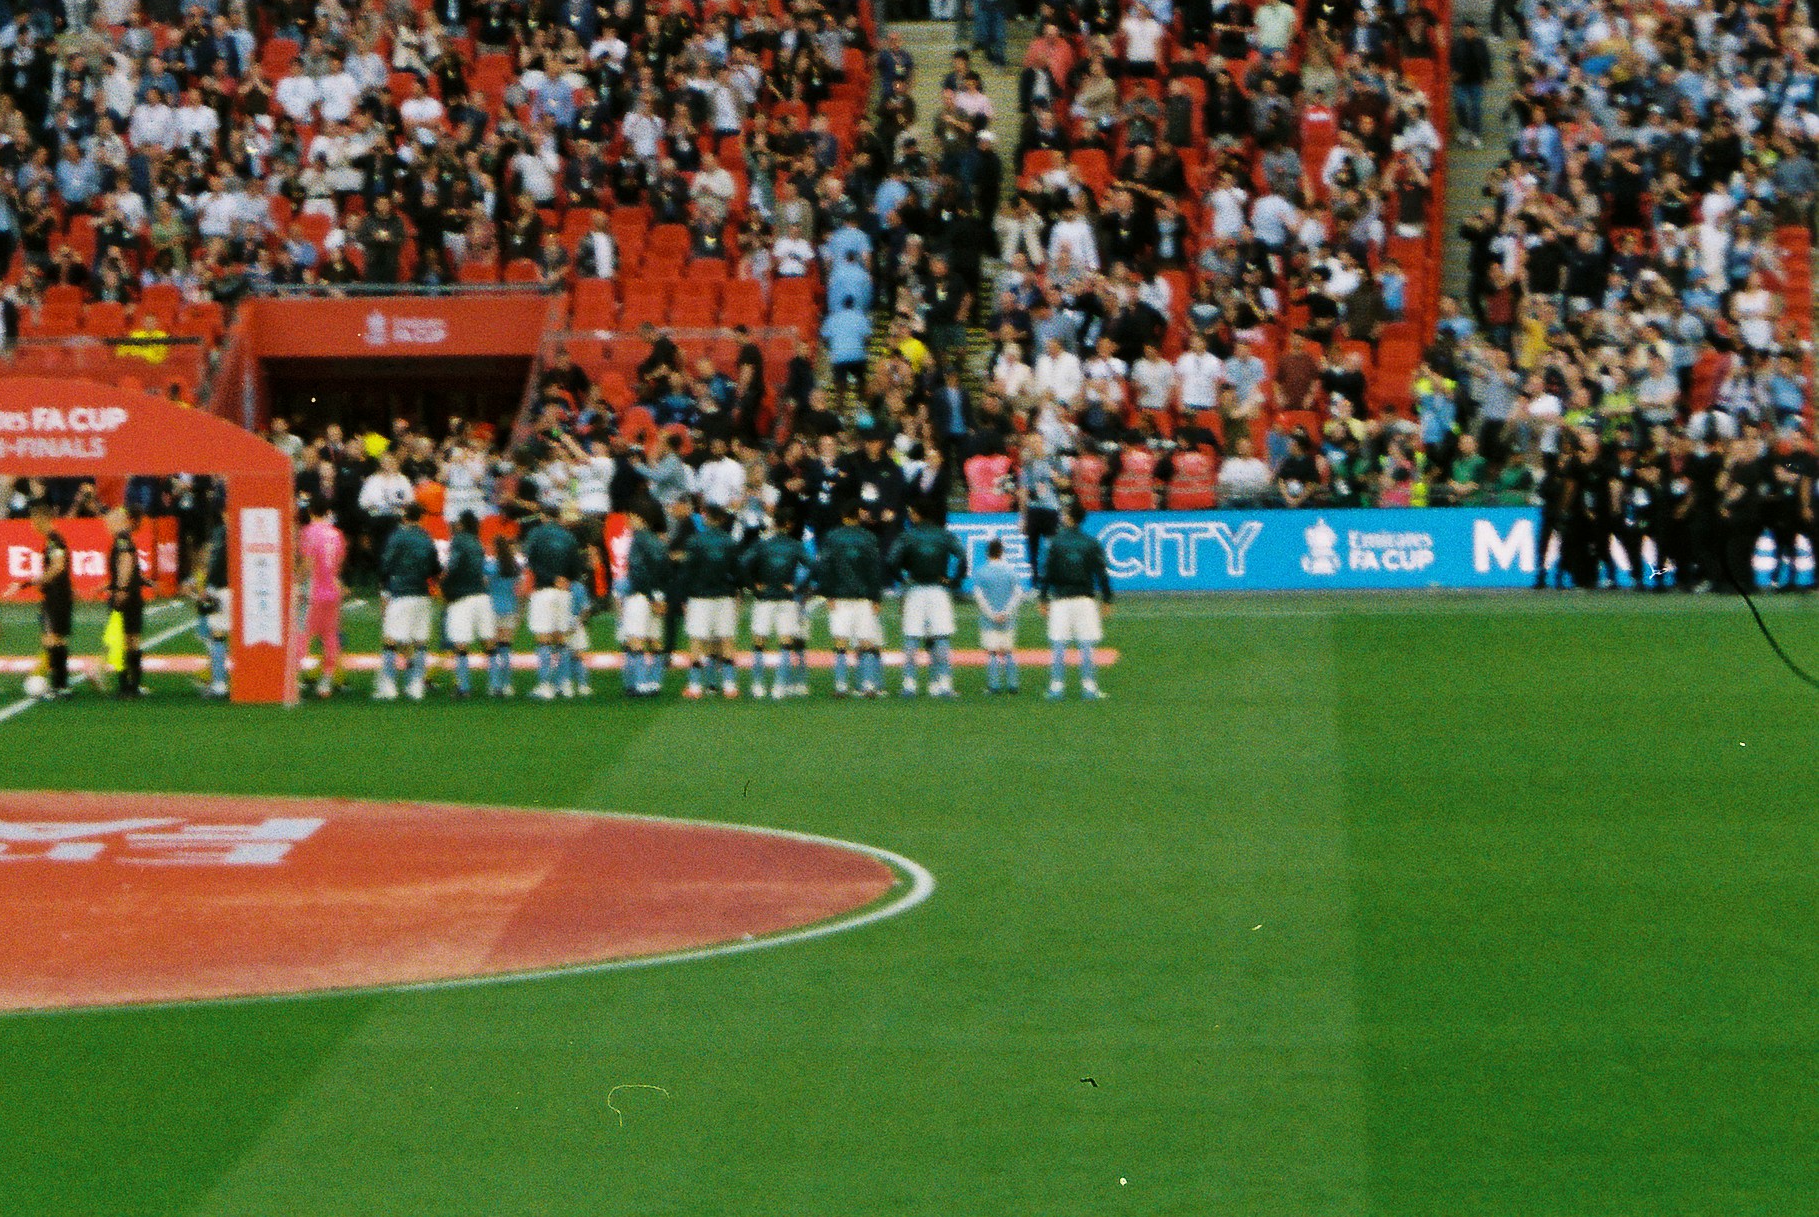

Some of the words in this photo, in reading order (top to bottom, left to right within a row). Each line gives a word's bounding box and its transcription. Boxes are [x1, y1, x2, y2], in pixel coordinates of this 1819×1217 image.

[32, 406, 67, 432] FA
[68, 406, 129, 432] CUP
[1101, 520, 1264, 579] CITY
[1348, 548, 1381, 571] FA
[1382, 548, 1436, 571] CUP
